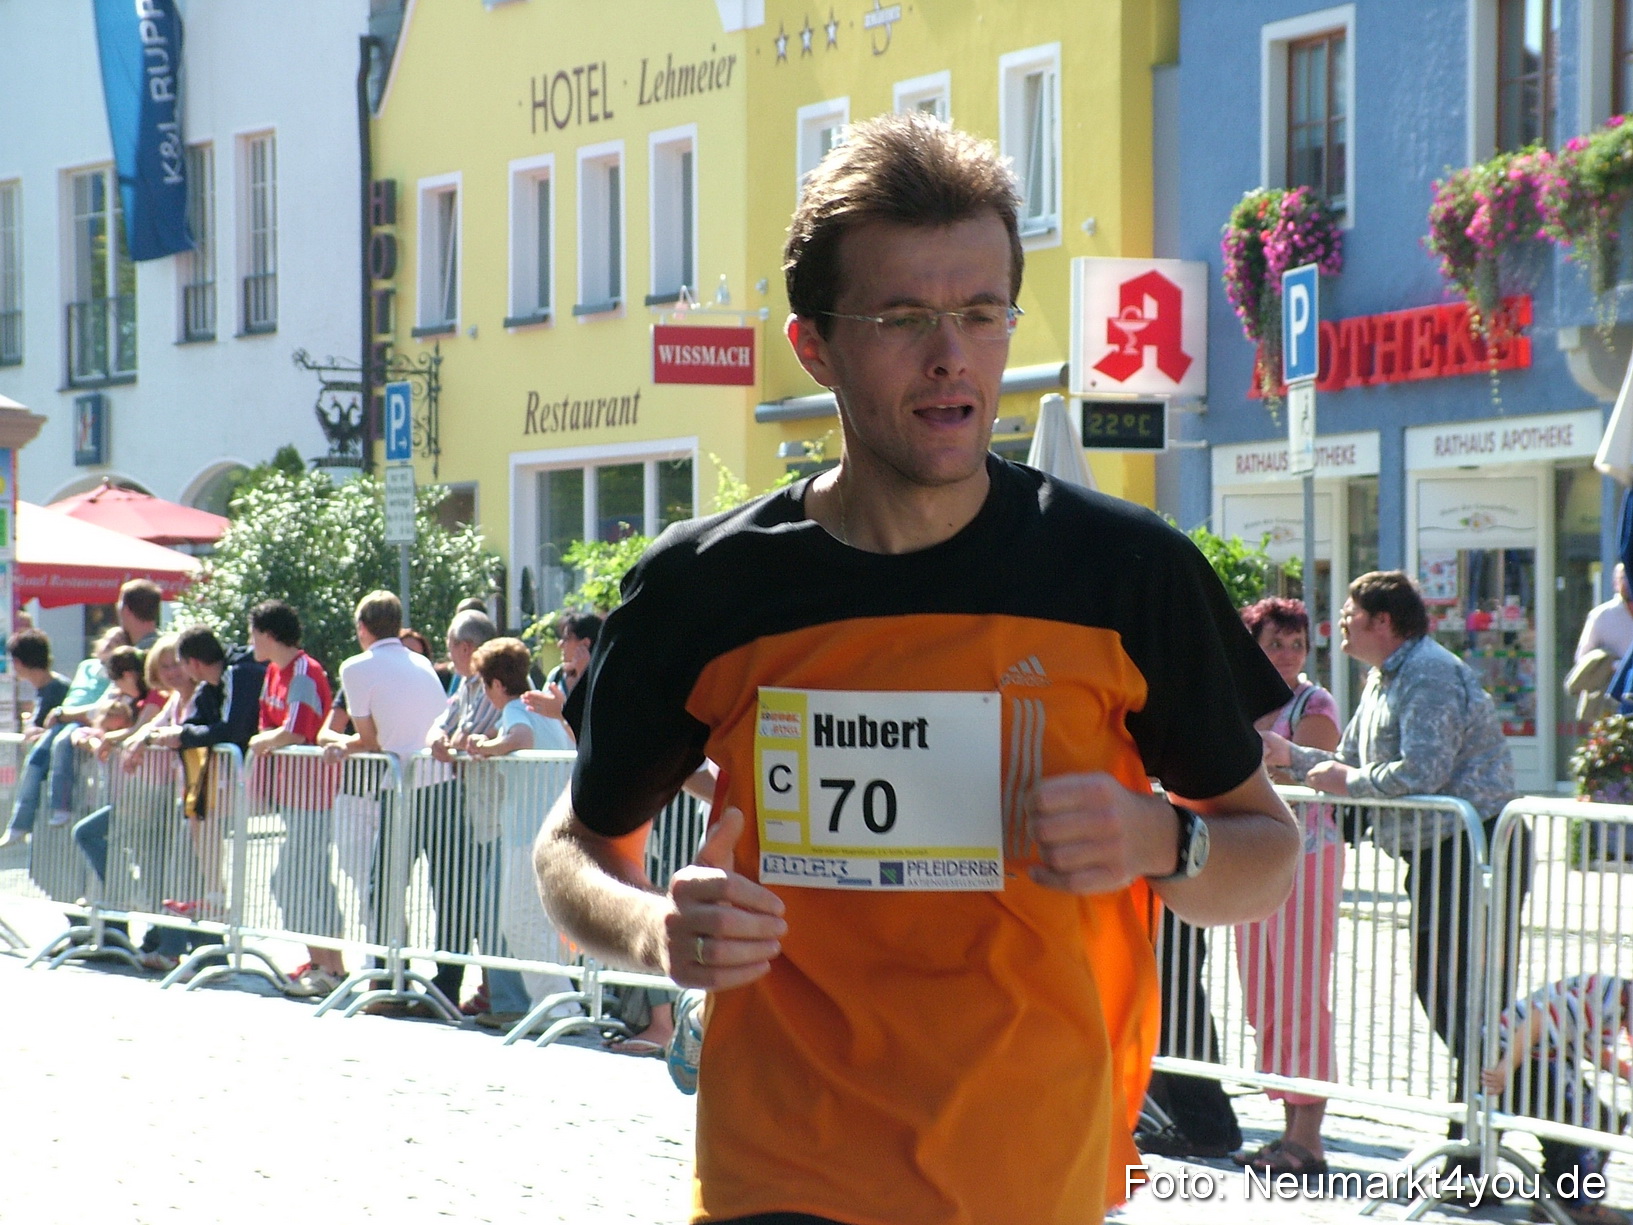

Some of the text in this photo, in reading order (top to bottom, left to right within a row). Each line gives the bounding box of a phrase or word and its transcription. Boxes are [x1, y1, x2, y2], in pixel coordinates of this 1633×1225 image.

[531, 43, 737, 135] HOTEL Lehmeier
[1289, 283, 1310, 367] P
[658, 344, 751, 367] WISSMACH
[390, 393, 406, 451] P
[523, 387, 641, 436] Restaurant
[1434, 423, 1574, 457] RATHAUS APOTHEKE
[1235, 451, 1288, 475] RATHAUS
[813, 712, 929, 749] Hubert
[768, 764, 793, 793] C
[820, 778, 898, 834] 70
[907, 860, 1000, 878] PFLEIDERER
